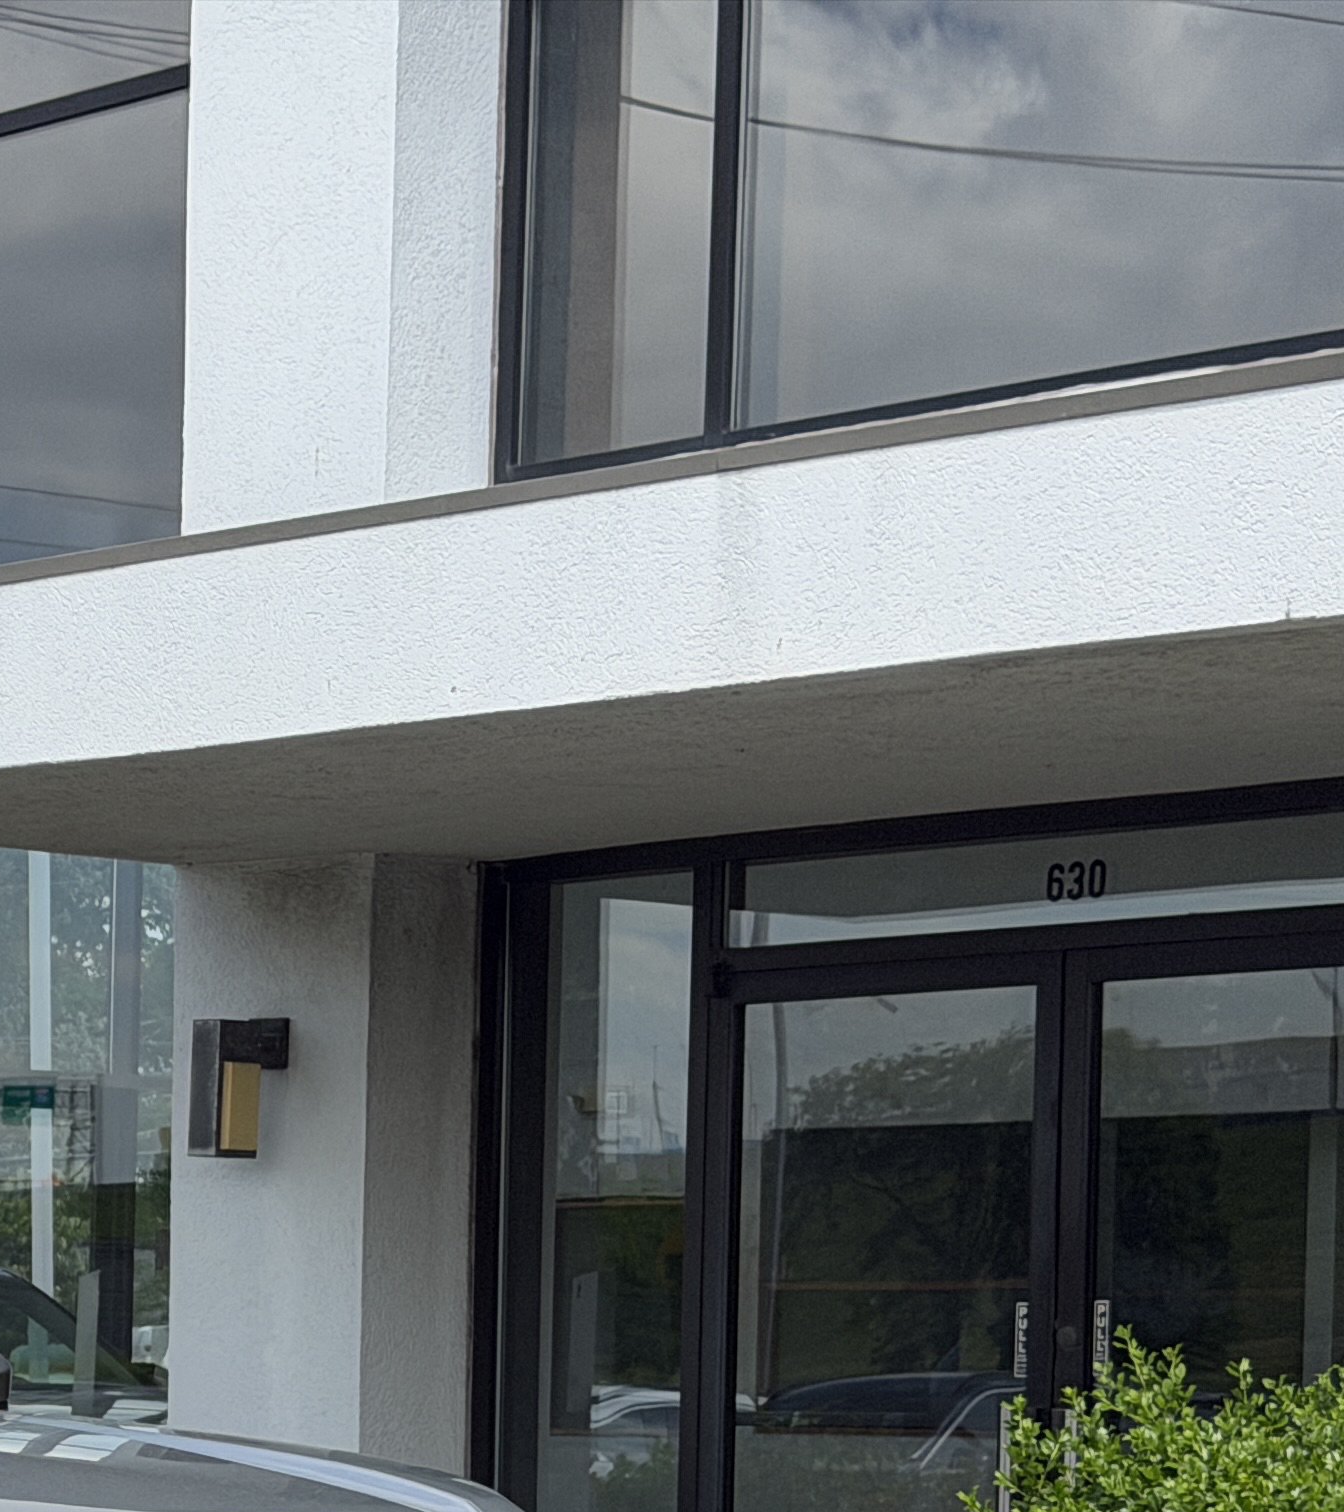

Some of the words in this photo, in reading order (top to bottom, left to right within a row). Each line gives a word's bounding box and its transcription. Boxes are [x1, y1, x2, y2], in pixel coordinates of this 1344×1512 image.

[1046, 858, 1108, 902] 630
[1017, 1306, 1029, 1354] PULL
[1096, 1304, 1106, 1352] PULL
